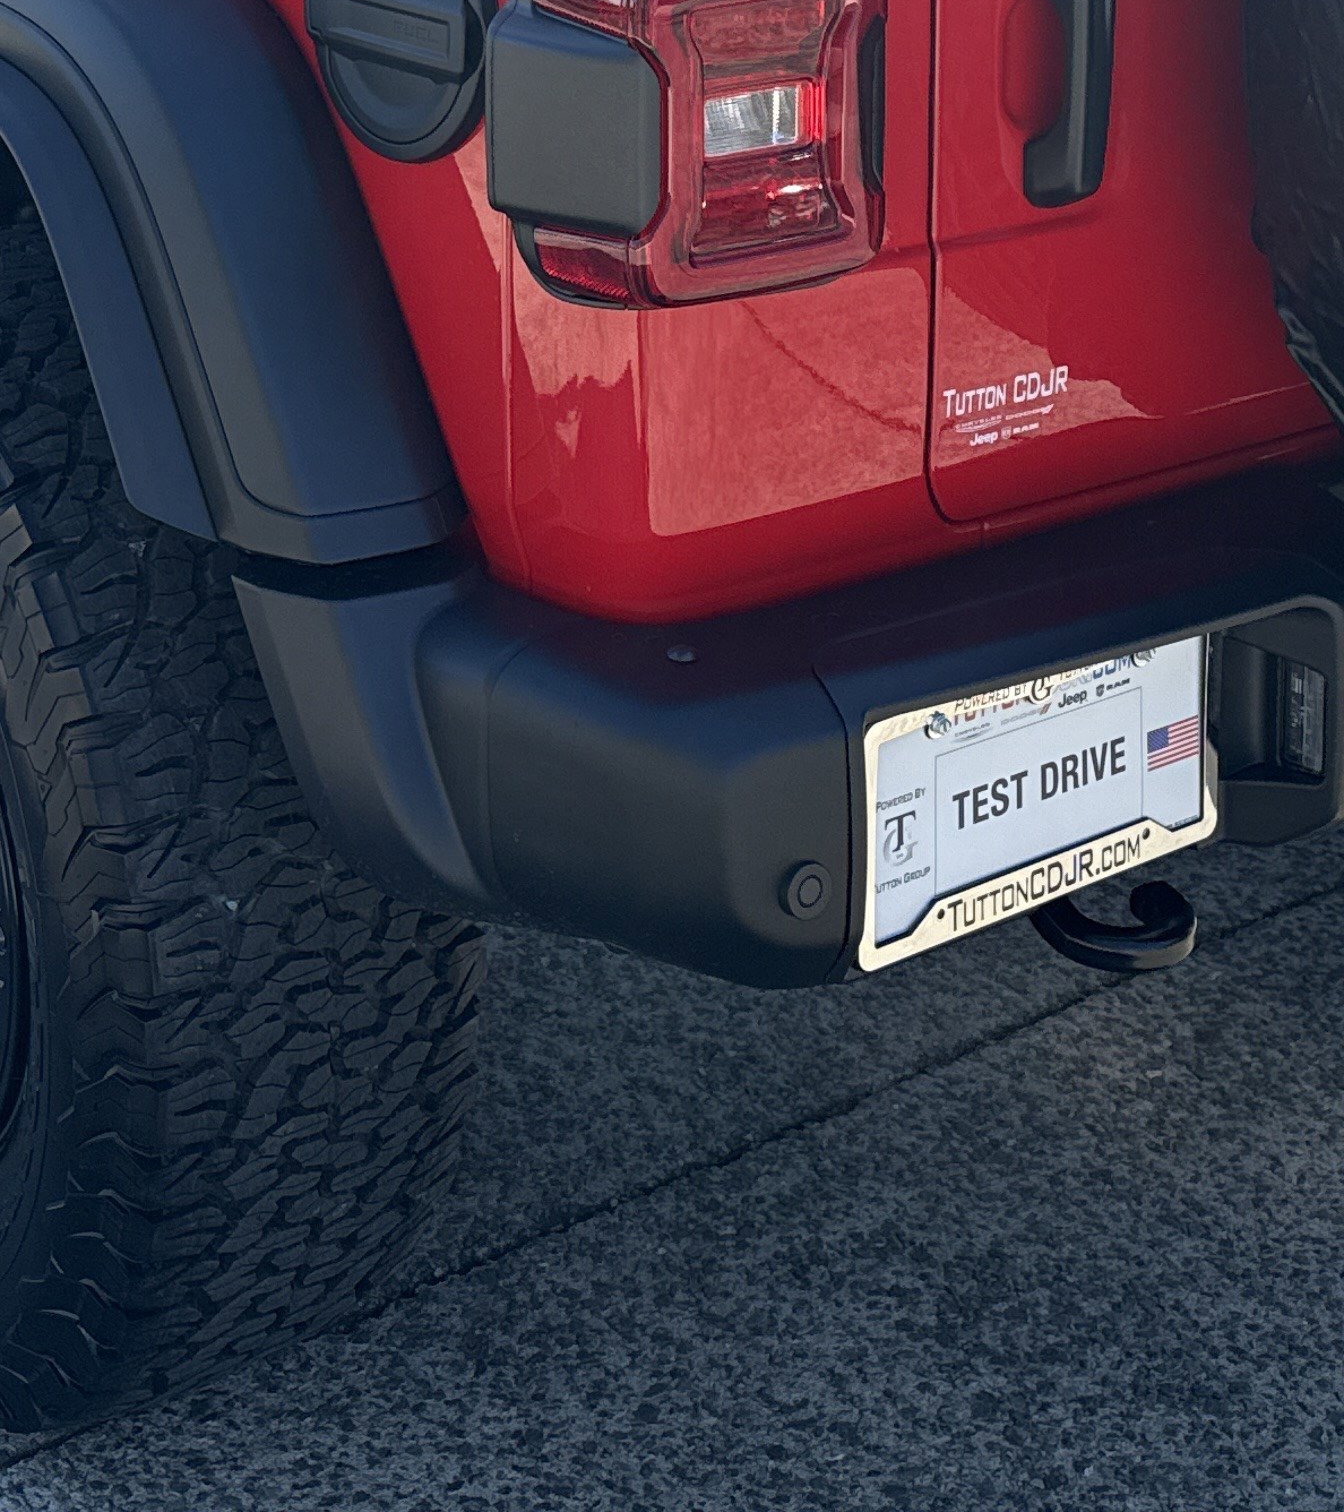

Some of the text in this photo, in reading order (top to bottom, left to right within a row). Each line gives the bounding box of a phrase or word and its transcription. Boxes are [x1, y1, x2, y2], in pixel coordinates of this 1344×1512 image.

[942, 365, 1069, 418] TUTTON CDJR
[1058, 690, 1088, 709] Jeep
[952, 735, 1127, 831] TEST DRIVE
[947, 833, 1142, 932] TUTTONCDJR.COM
